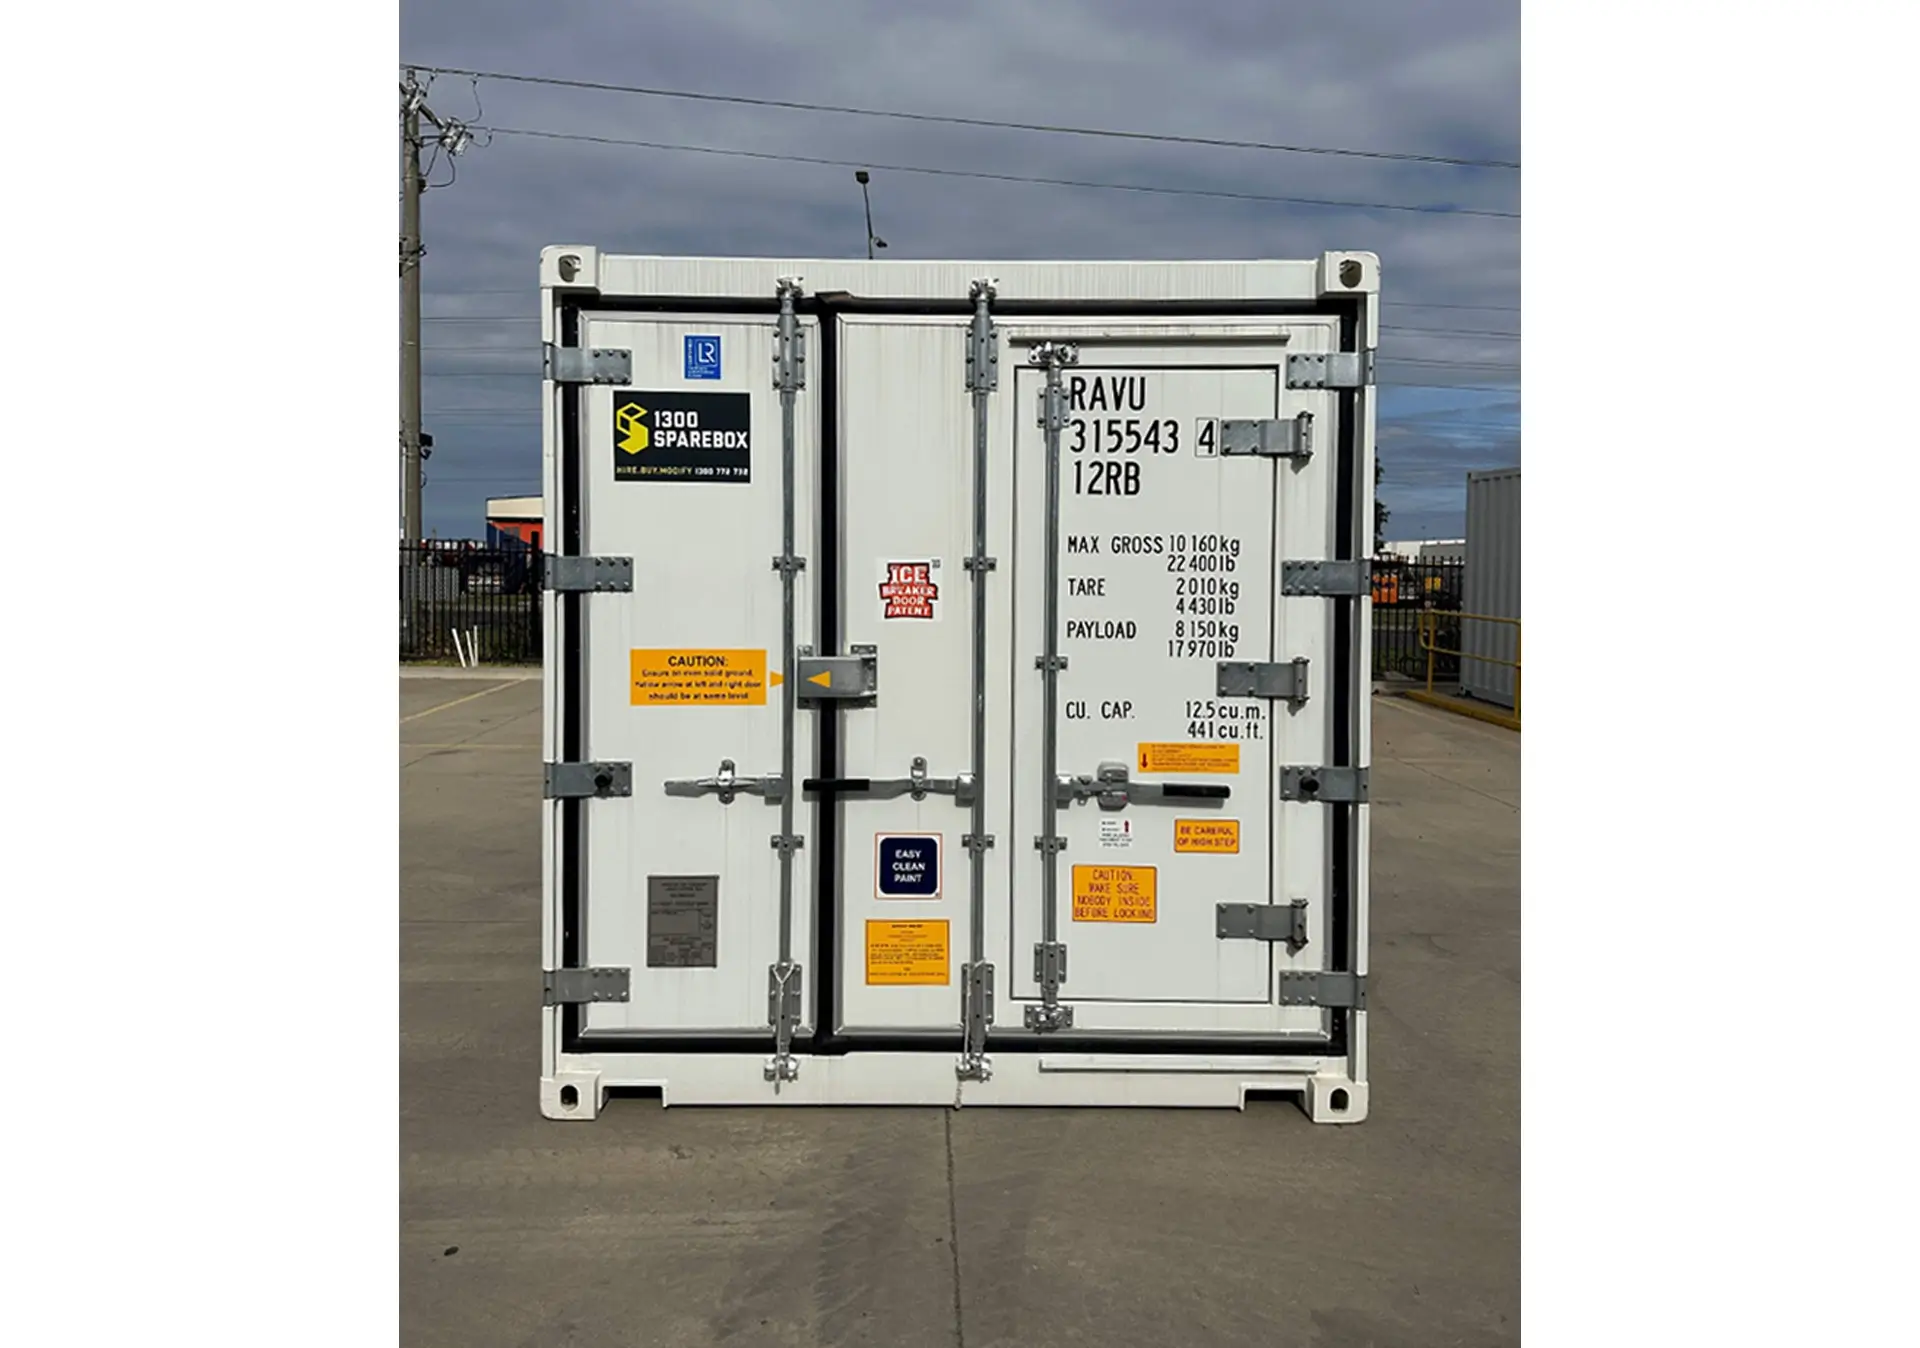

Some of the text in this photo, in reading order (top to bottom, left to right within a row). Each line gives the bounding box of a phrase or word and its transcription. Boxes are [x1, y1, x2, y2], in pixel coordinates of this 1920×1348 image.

[1070, 376, 1146, 411] RAVU
[654, 411, 698, 428] 1300
[654, 431, 748, 448] SPAREBOX
[1070, 419, 1215, 454] 315543 4
[1074, 461, 1141, 495] 12RB
[1067, 536, 1099, 554] MAX
[1111, 536, 1164, 554] GROSS
[890, 565, 928, 585] ICE
[1067, 578, 1106, 596] TARE
[892, 596, 925, 606] DOOR
[887, 605, 932, 616] PATENT
[1066, 621, 1137, 639] PAYLOAD
[668, 655, 729, 667] CAUTION:
[1066, 702, 1091, 719] CU.
[1101, 702, 1136, 719] CAP.
[1194, 826, 1234, 836] CAREFUL
[1191, 837, 1213, 847] HIGH
[1214, 838, 1236, 847] STEP
[895, 849, 922, 859] EASY
[892, 862, 926, 871] CLEAN
[894, 874, 923, 883] PAINT
[1089, 882, 1140, 895] MAKE SURE
[1077, 895, 1150, 907] NOBODY INSIDE
[1075, 907, 1154, 919] BEFORE LOCKING
